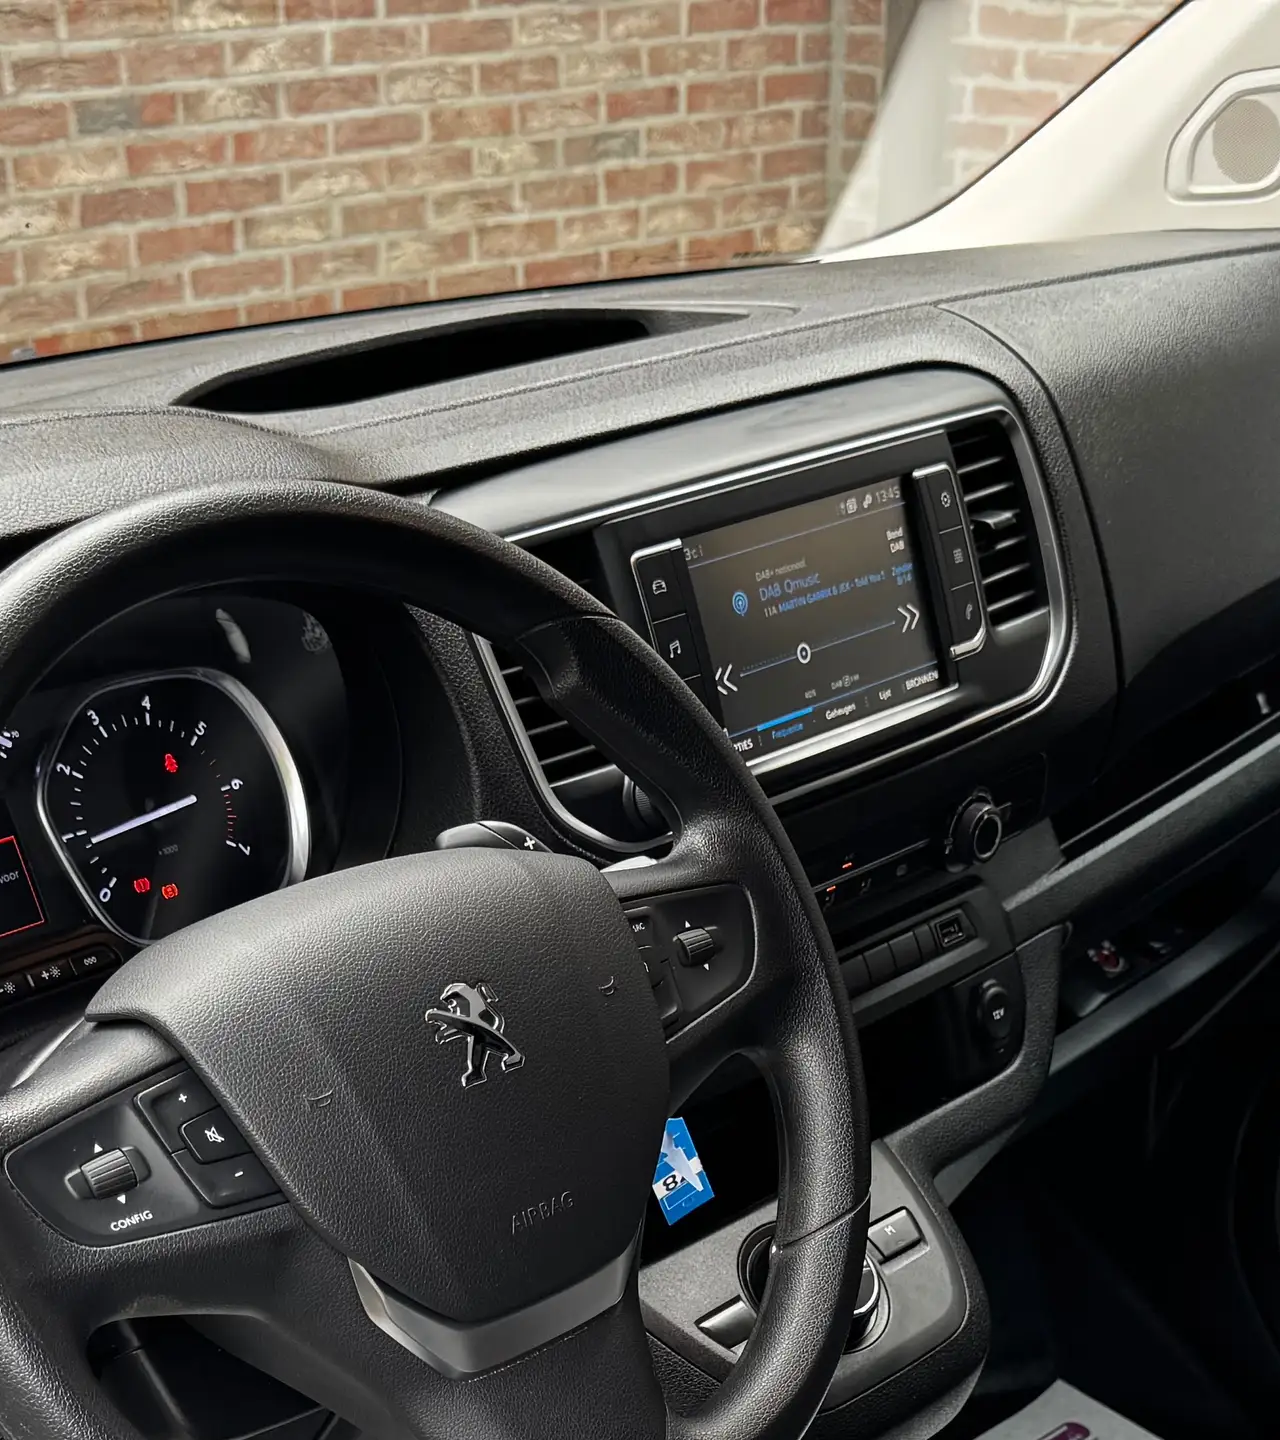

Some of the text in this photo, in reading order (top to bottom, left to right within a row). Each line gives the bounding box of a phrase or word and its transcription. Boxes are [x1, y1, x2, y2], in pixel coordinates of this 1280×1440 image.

[759, 582, 781, 601] DAB
[141, 694, 151, 711] 4
[86, 708, 101, 726] 3
[194, 720, 208, 737] 5
[56, 762, 71, 776] 2
[230, 777, 244, 791] 6
[99, 886, 112, 903] 0
[110, 1209, 154, 1231] CONFIG
[511, 1190, 574, 1234] AIRBAG
